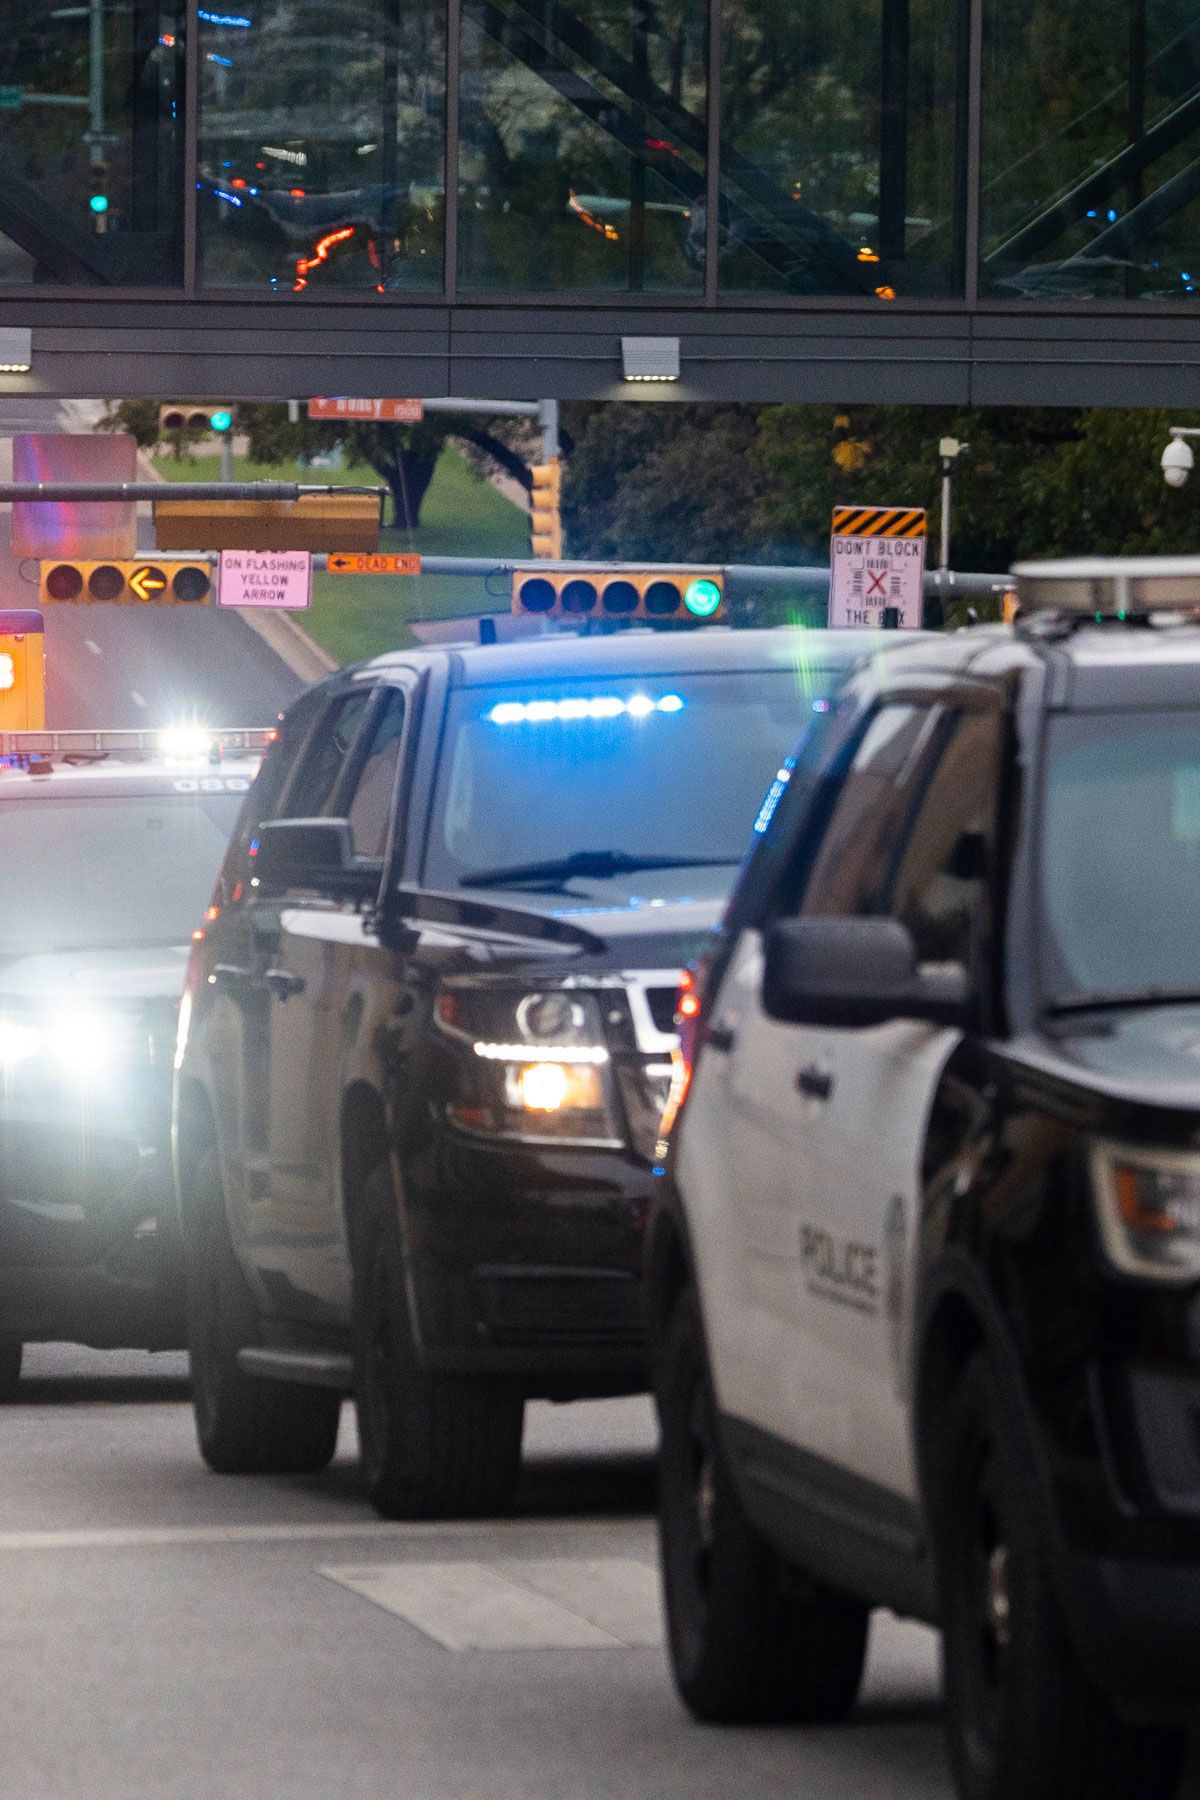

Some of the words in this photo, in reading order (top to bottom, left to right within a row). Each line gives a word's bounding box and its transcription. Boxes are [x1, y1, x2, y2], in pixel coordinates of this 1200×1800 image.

[878, 541, 919, 556] BLOCK
[225, 559, 241, 569] ON
[246, 559, 306, 570] FLASHING
[357, 557, 388, 569] DEAD
[394, 557, 416, 570] END
[241, 574, 288, 586] YELLOW
[243, 589, 285, 600] ARROW
[846, 609, 870, 624] THE
[878, 610, 905, 625] BX
[174, 779, 250, 792] 086
